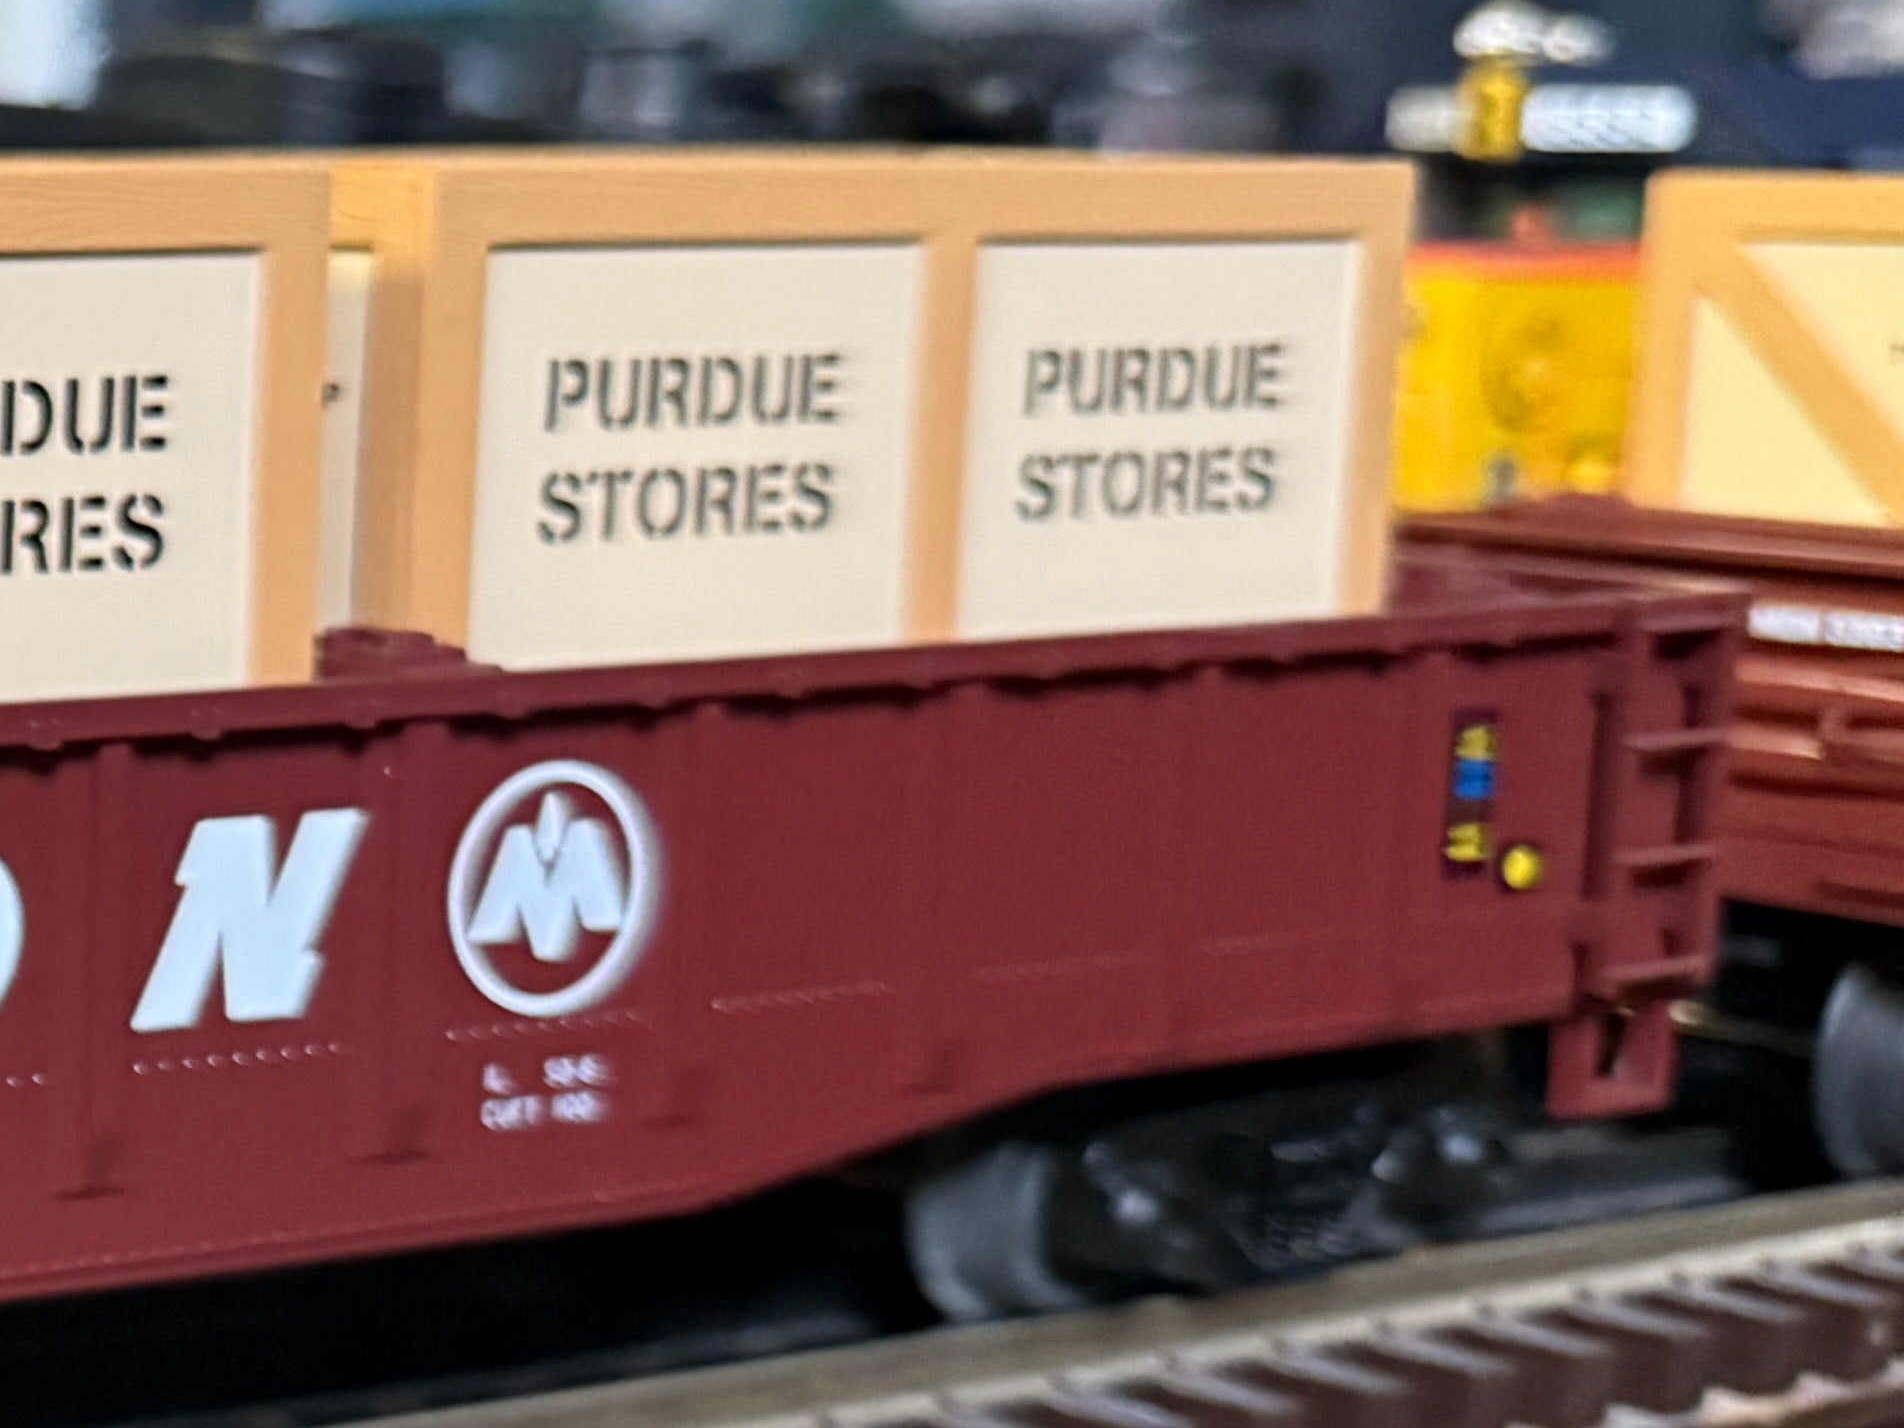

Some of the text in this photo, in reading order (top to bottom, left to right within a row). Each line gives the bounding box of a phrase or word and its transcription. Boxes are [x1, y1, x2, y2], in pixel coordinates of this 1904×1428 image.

[542, 352, 843, 433] PURDUE
[1023, 340, 1284, 417] PURDUE
[537, 461, 836, 546] STORES
[1016, 446, 1278, 522] STORES
